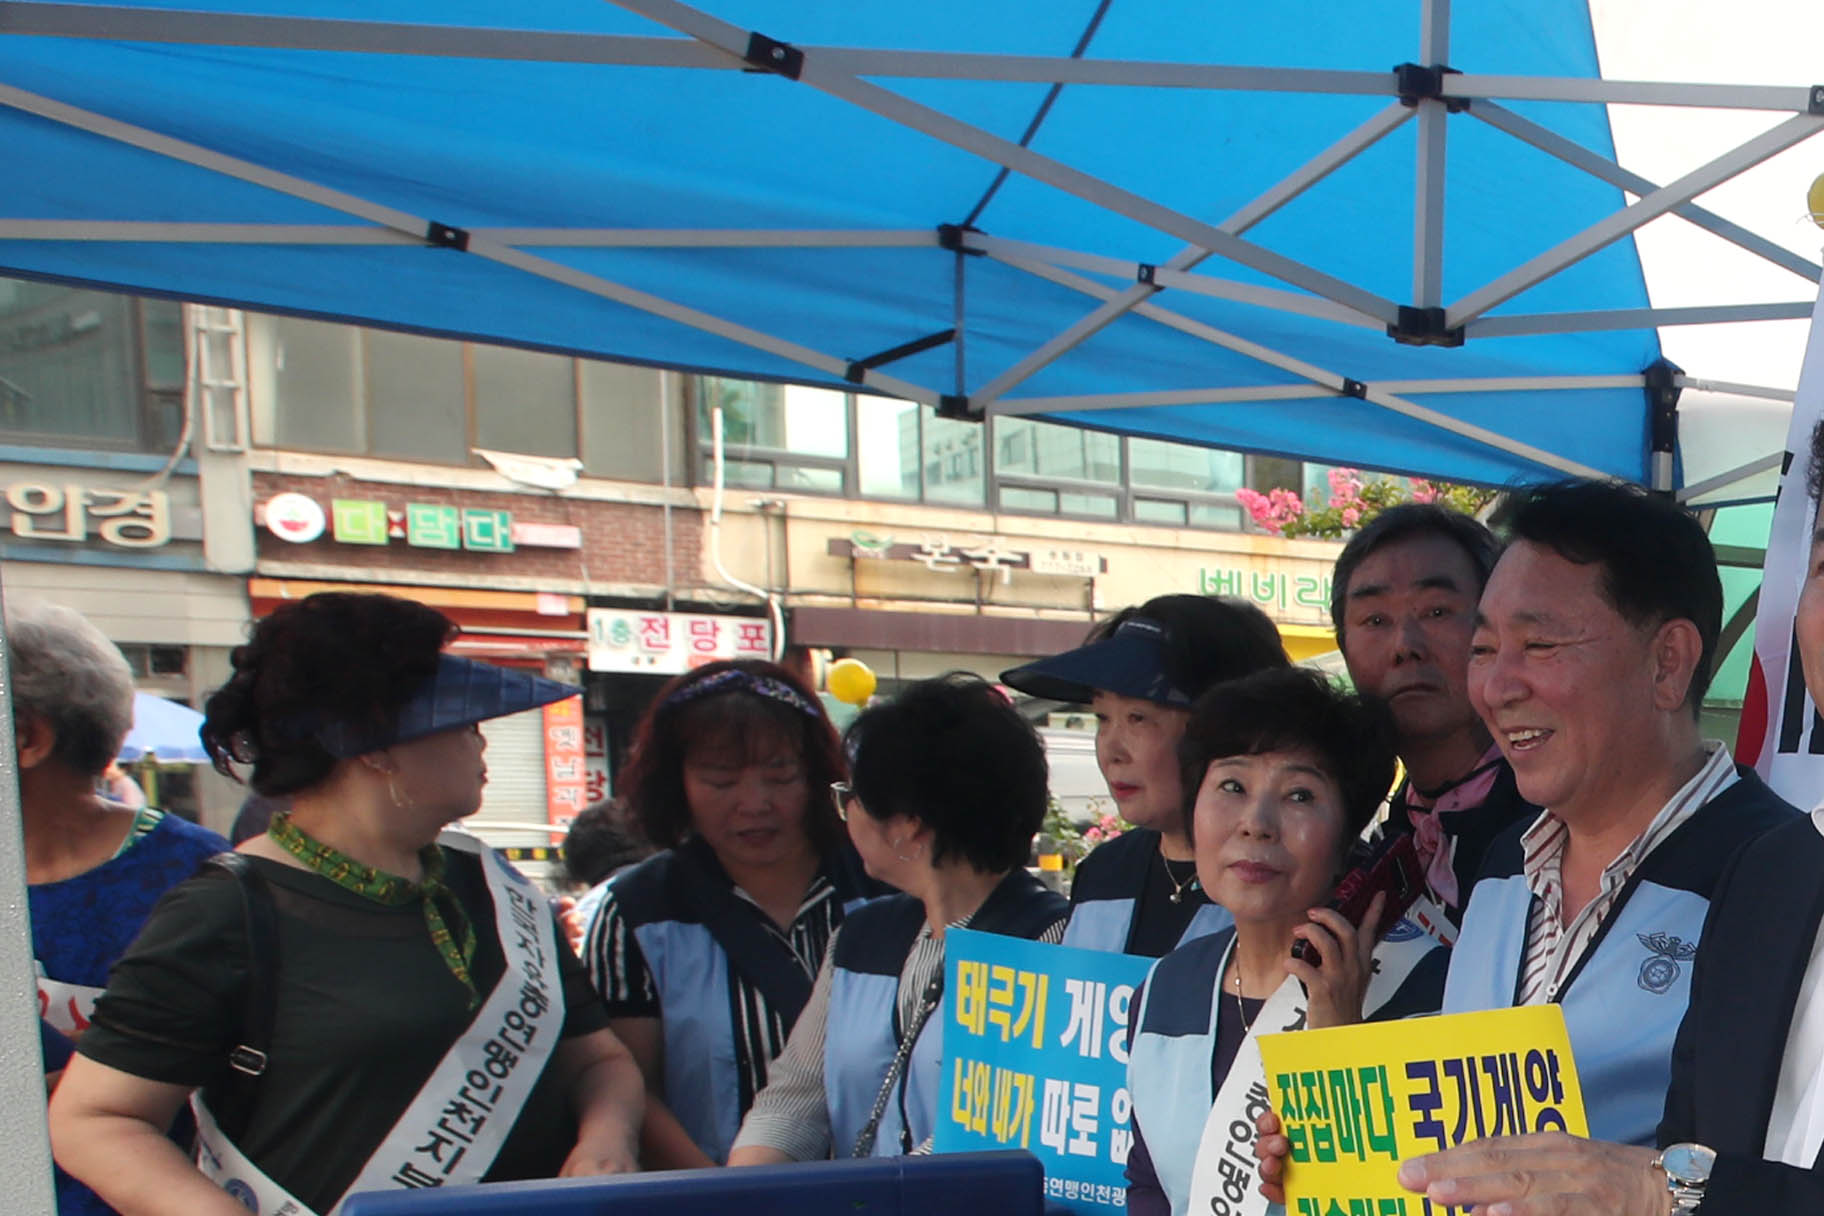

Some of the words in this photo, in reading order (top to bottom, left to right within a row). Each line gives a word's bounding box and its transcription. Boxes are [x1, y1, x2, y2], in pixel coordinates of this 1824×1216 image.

[7, 483, 171, 547] 안경
[640, 617, 769, 653] 전당포
[955, 959, 1049, 1049] 태극기
[1041, 1078, 1099, 1157] 따로
[1277, 1065, 1399, 1163] 집집마다
[1405, 1049, 1567, 1159] 국기게양
[1043, 1177, 1127, 1207] 연맹인천광
